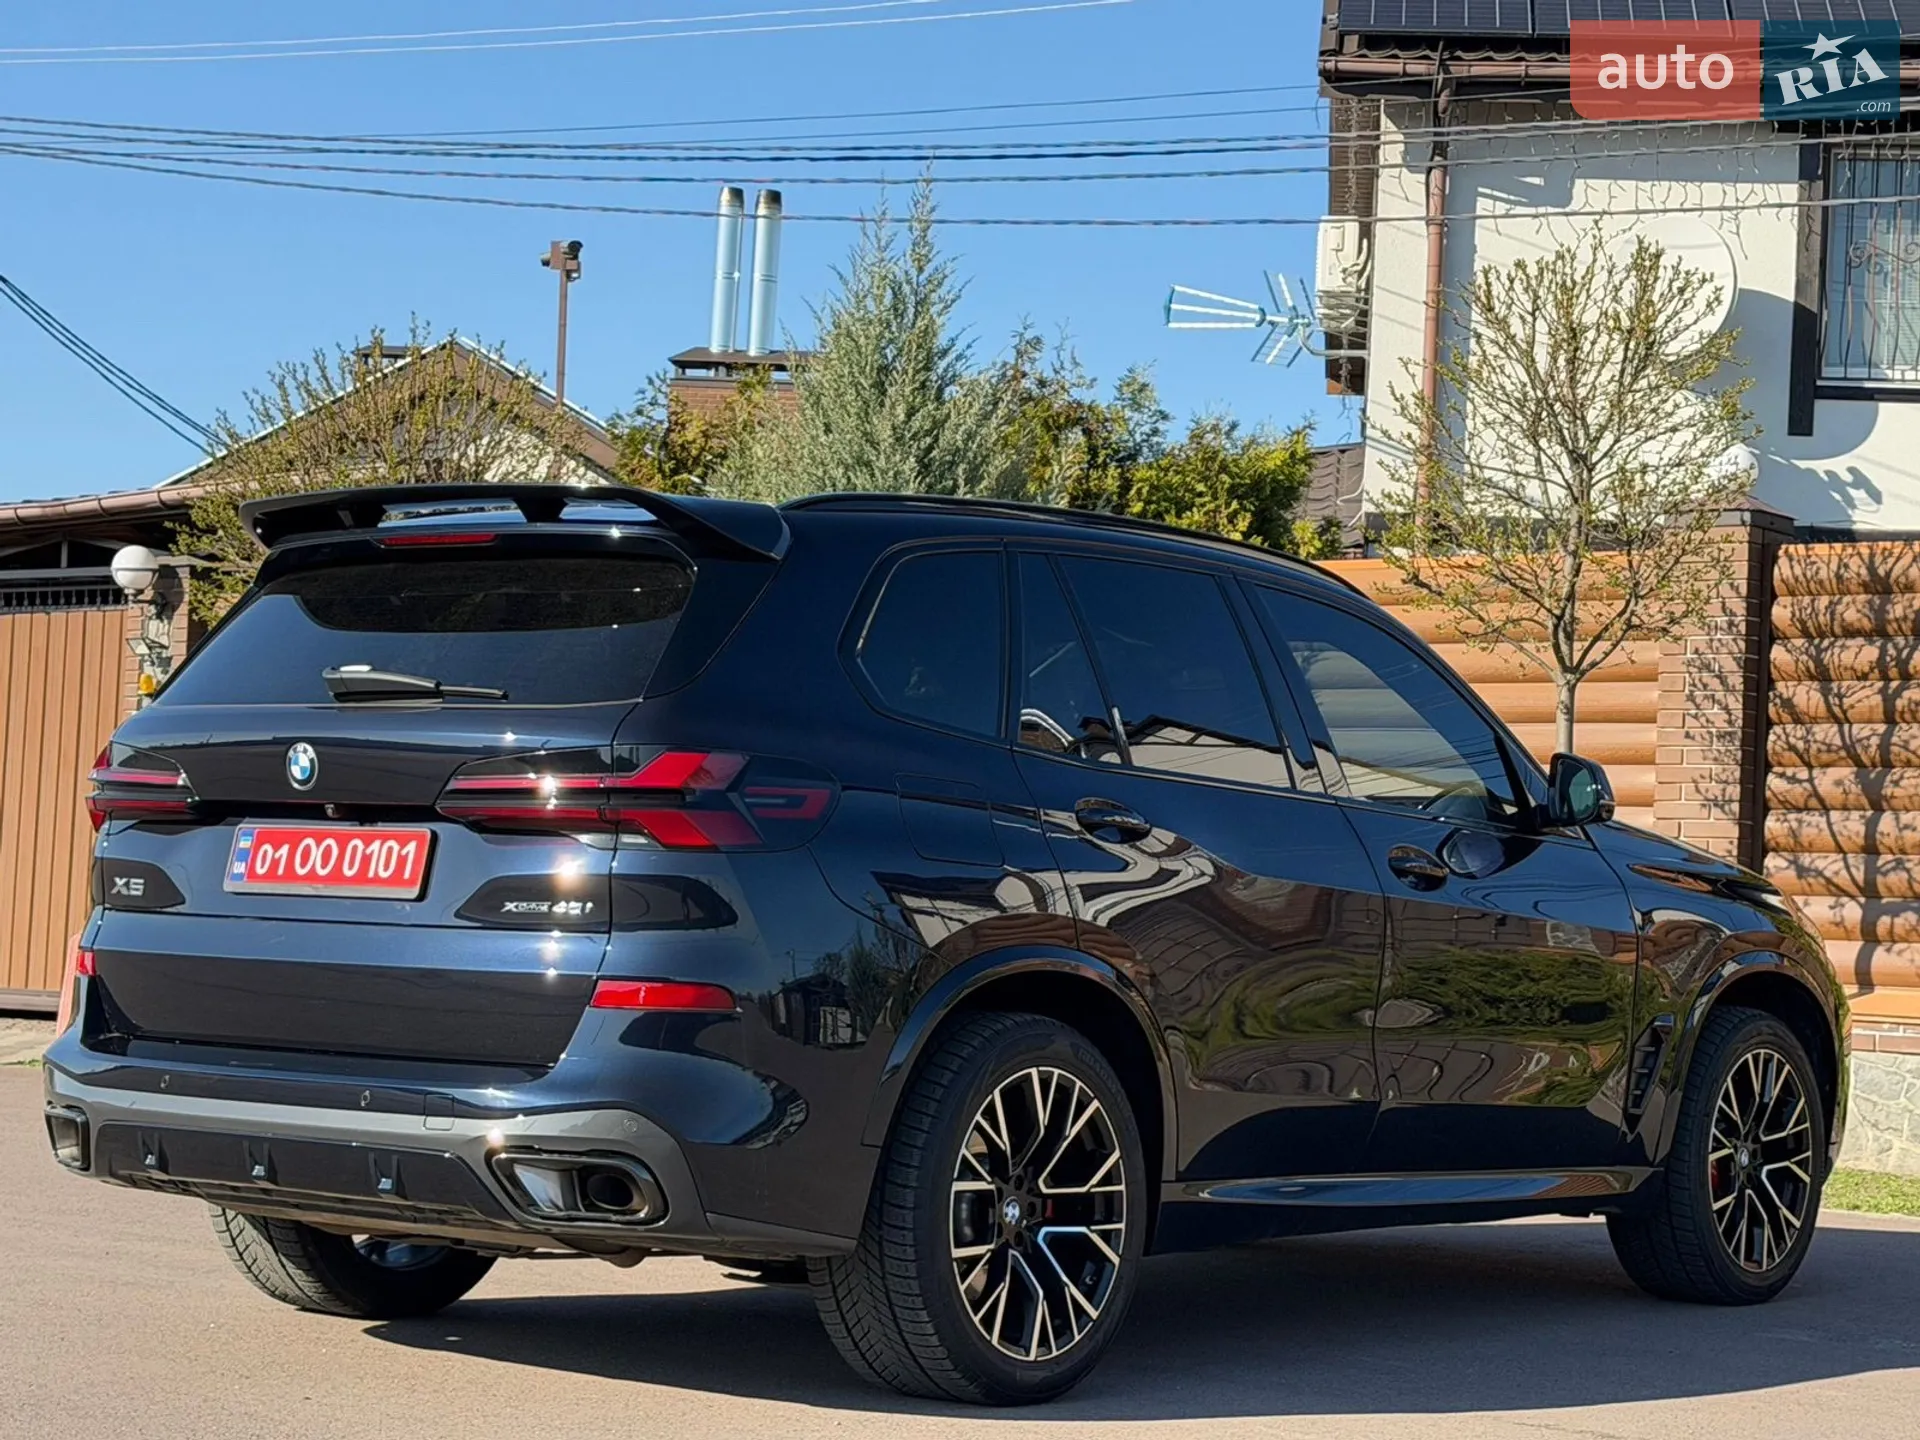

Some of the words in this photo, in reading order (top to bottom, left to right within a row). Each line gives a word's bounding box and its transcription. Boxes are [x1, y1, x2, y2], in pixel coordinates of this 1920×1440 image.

[233, 862, 245, 874] UA
[255, 843, 290, 875] 01
[342, 838, 418, 880] 0101
[110, 877, 145, 896] X5
